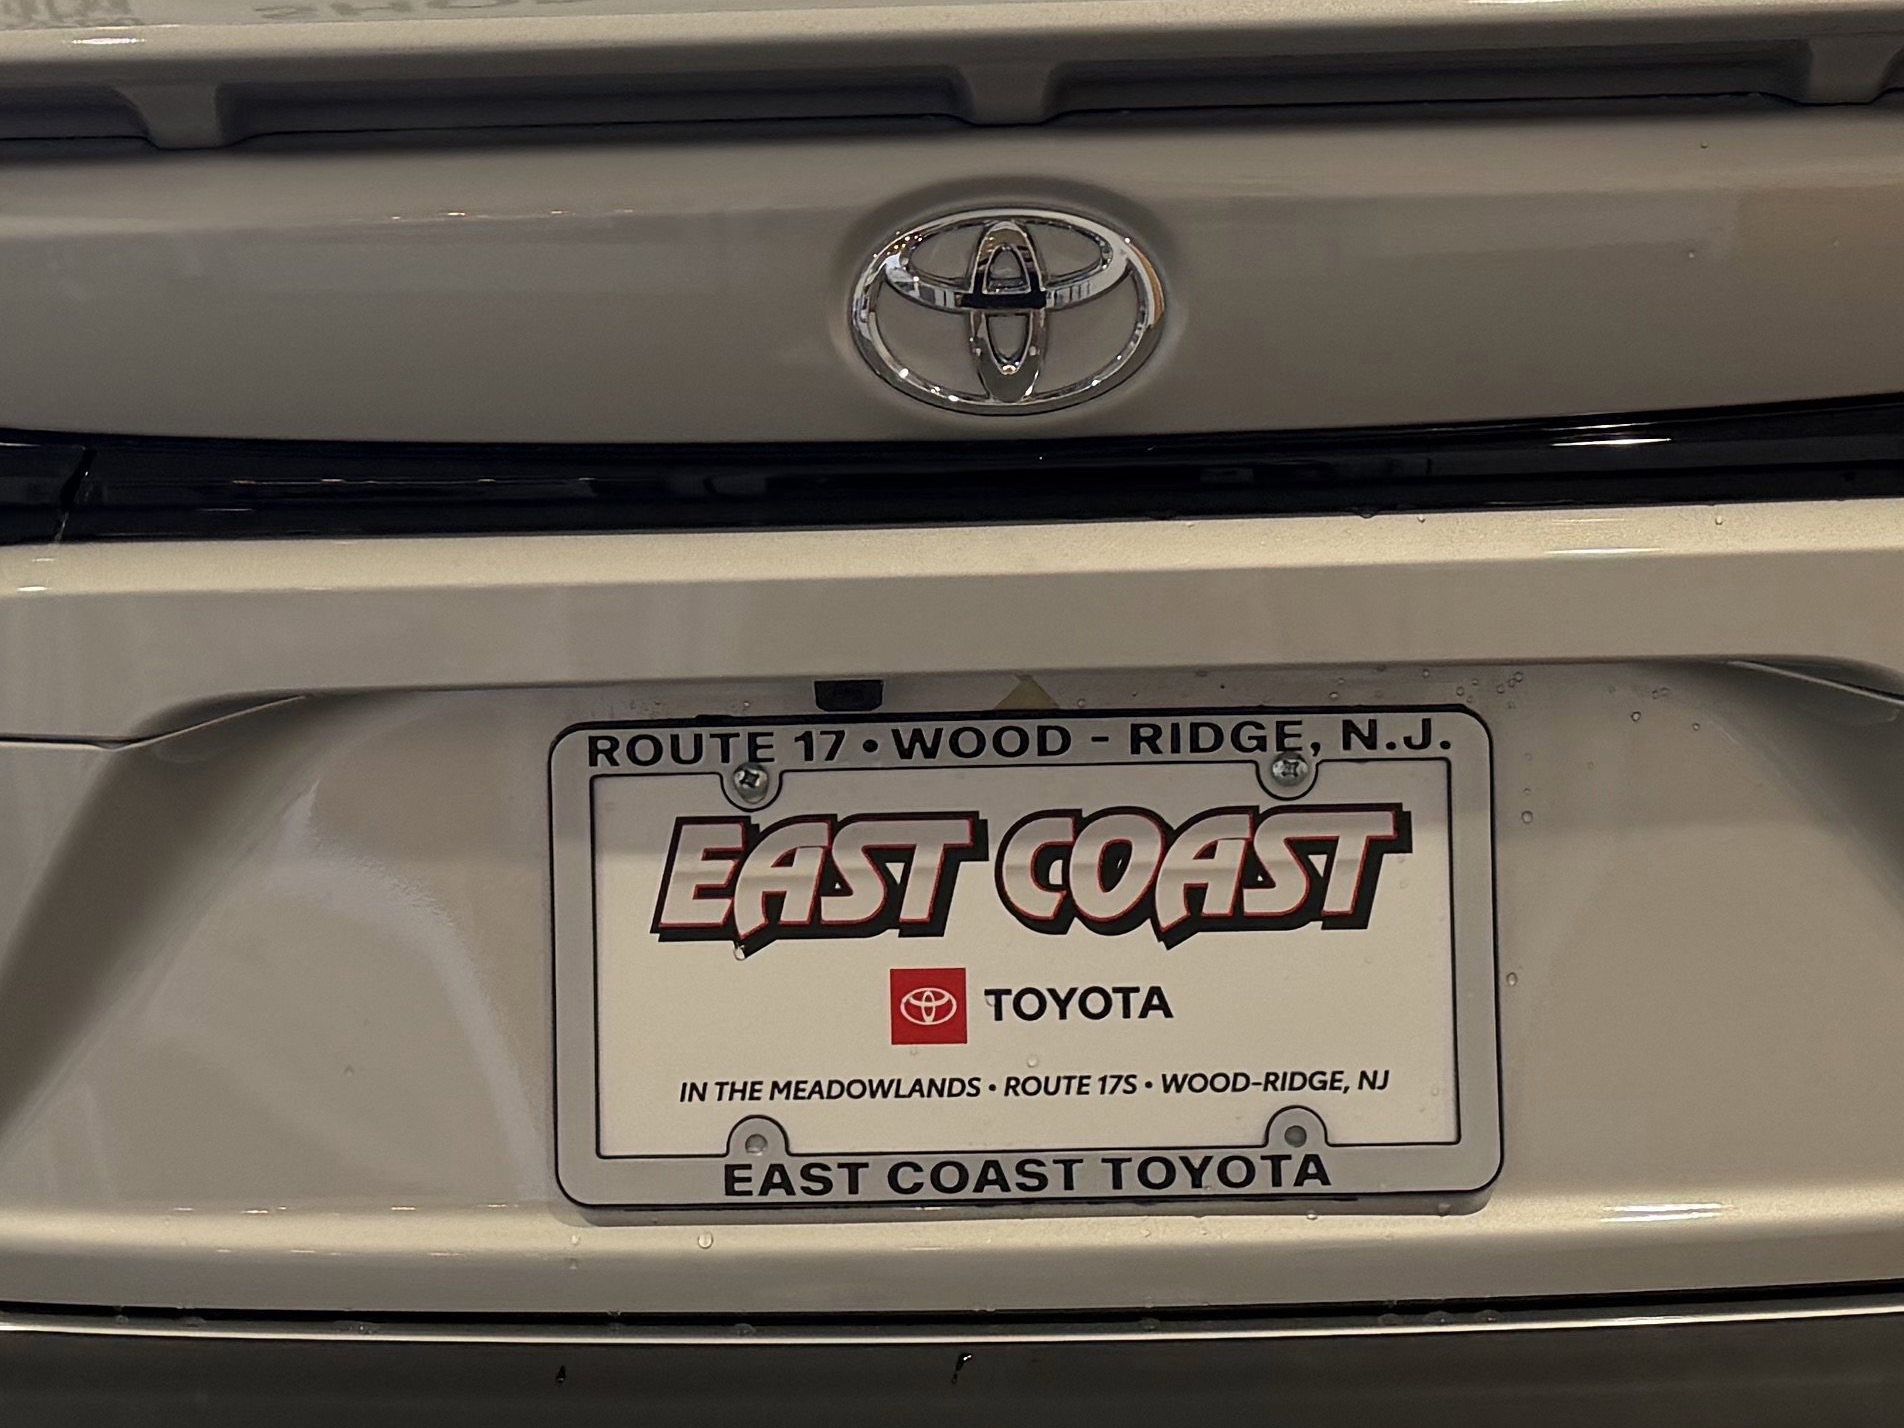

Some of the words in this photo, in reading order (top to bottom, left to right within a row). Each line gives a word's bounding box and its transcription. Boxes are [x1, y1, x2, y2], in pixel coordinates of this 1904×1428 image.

[588, 732, 777, 768] ROUTE
[793, 730, 846, 764] 17
[892, 726, 1073, 761] WOOD
[1129, 719, 1322, 759] RIDGE,
[1341, 718, 1453, 753] N.J.
[649, 811, 988, 957] EAST
[995, 803, 1414, 949] COAST
[984, 985, 1174, 1024] TOYOTA
[679, 1082, 707, 1103] IN
[713, 1081, 764, 1103] THE
[767, 1076, 982, 1101] MEADOWLANDS
[1002, 1074, 1092, 1099] ROUTE
[1099, 1073, 1139, 1097] 17S
[1160, 1069, 1350, 1098] WOOD-RIDGE,
[1357, 1069, 1390, 1093] NJ
[723, 1161, 870, 1199] EAST
[886, 1157, 1086, 1194] COAST
[1101, 1153, 1331, 1190] TOYOTA
